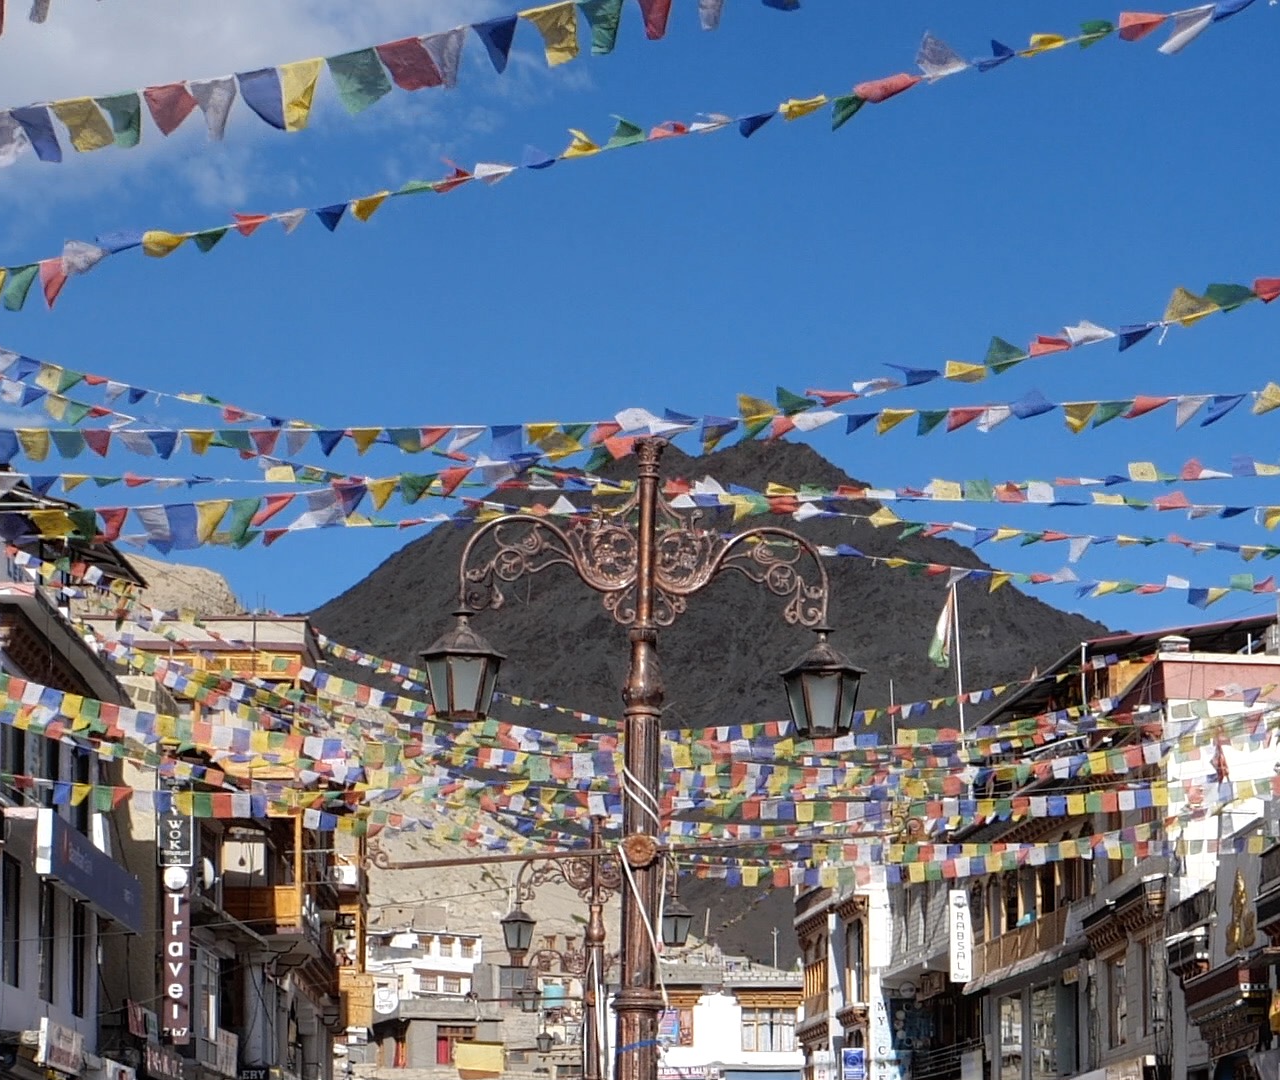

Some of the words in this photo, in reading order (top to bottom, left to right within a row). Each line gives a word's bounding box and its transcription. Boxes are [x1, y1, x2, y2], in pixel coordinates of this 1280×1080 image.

[166, 820, 184, 850] WOK
[167, 893, 185, 1020] Travel
[956, 911, 966, 971] RABSAL
[877, 1001, 887, 1027] MY
